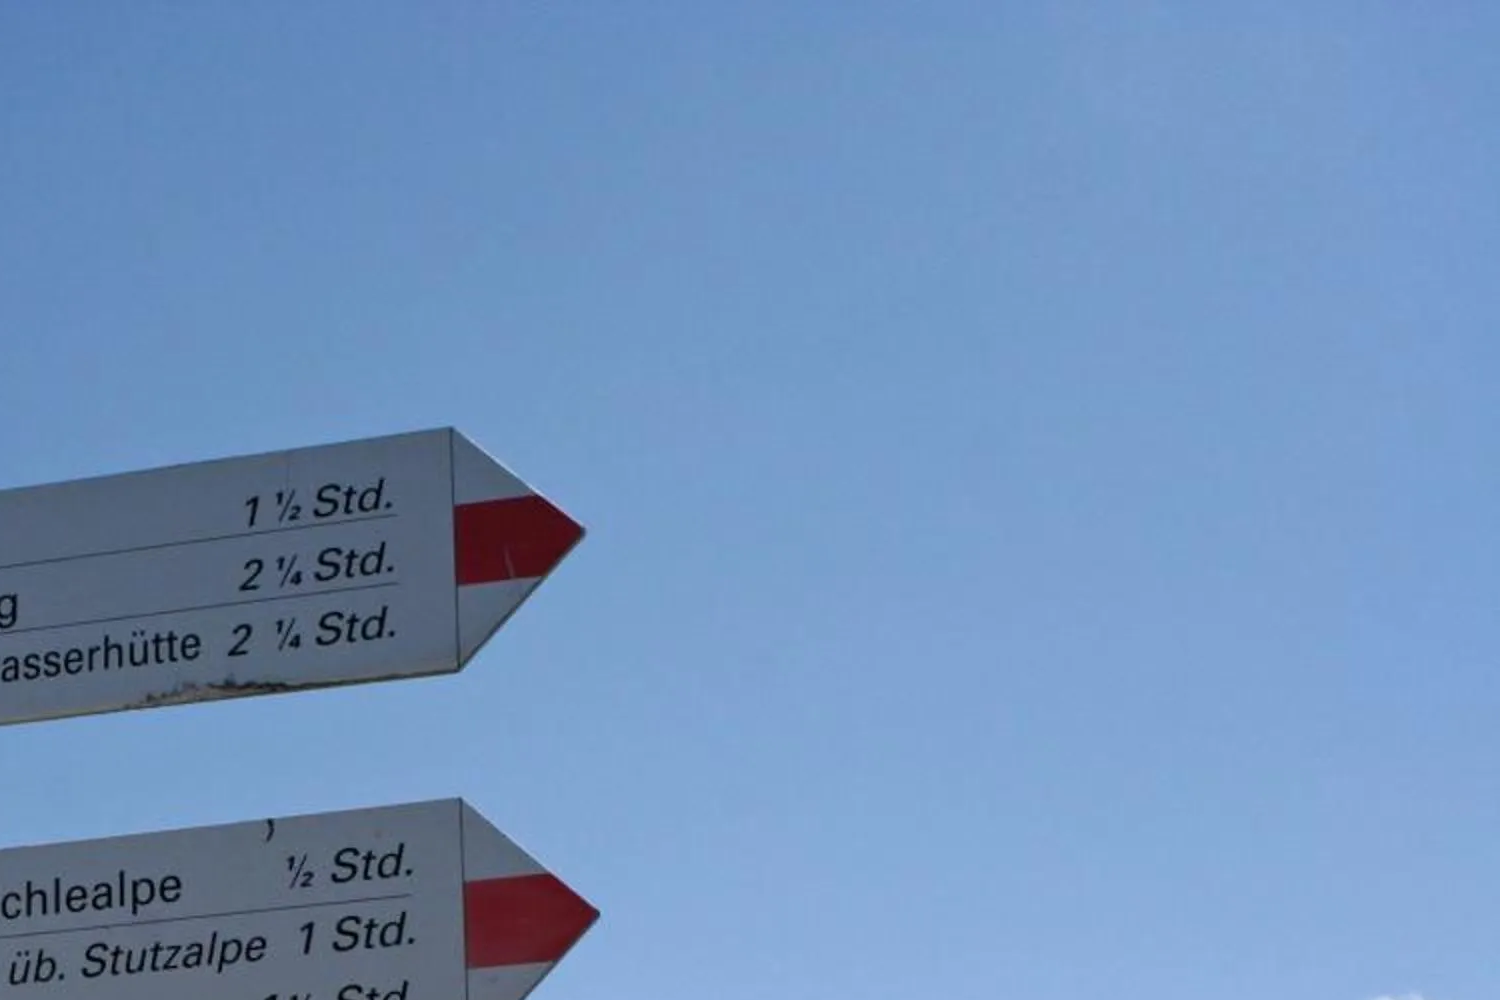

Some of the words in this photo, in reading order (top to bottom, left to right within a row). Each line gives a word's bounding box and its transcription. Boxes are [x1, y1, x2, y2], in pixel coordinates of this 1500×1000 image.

[313, 477, 392, 518] Std.
[314, 541, 394, 582] Std.
[315, 605, 396, 646] Std.
[331, 842, 413, 884] Std.
[8, 948, 65, 986] üb.
[81, 930, 267, 979] Stutzalpe
[331, 911, 415, 953] Std.
